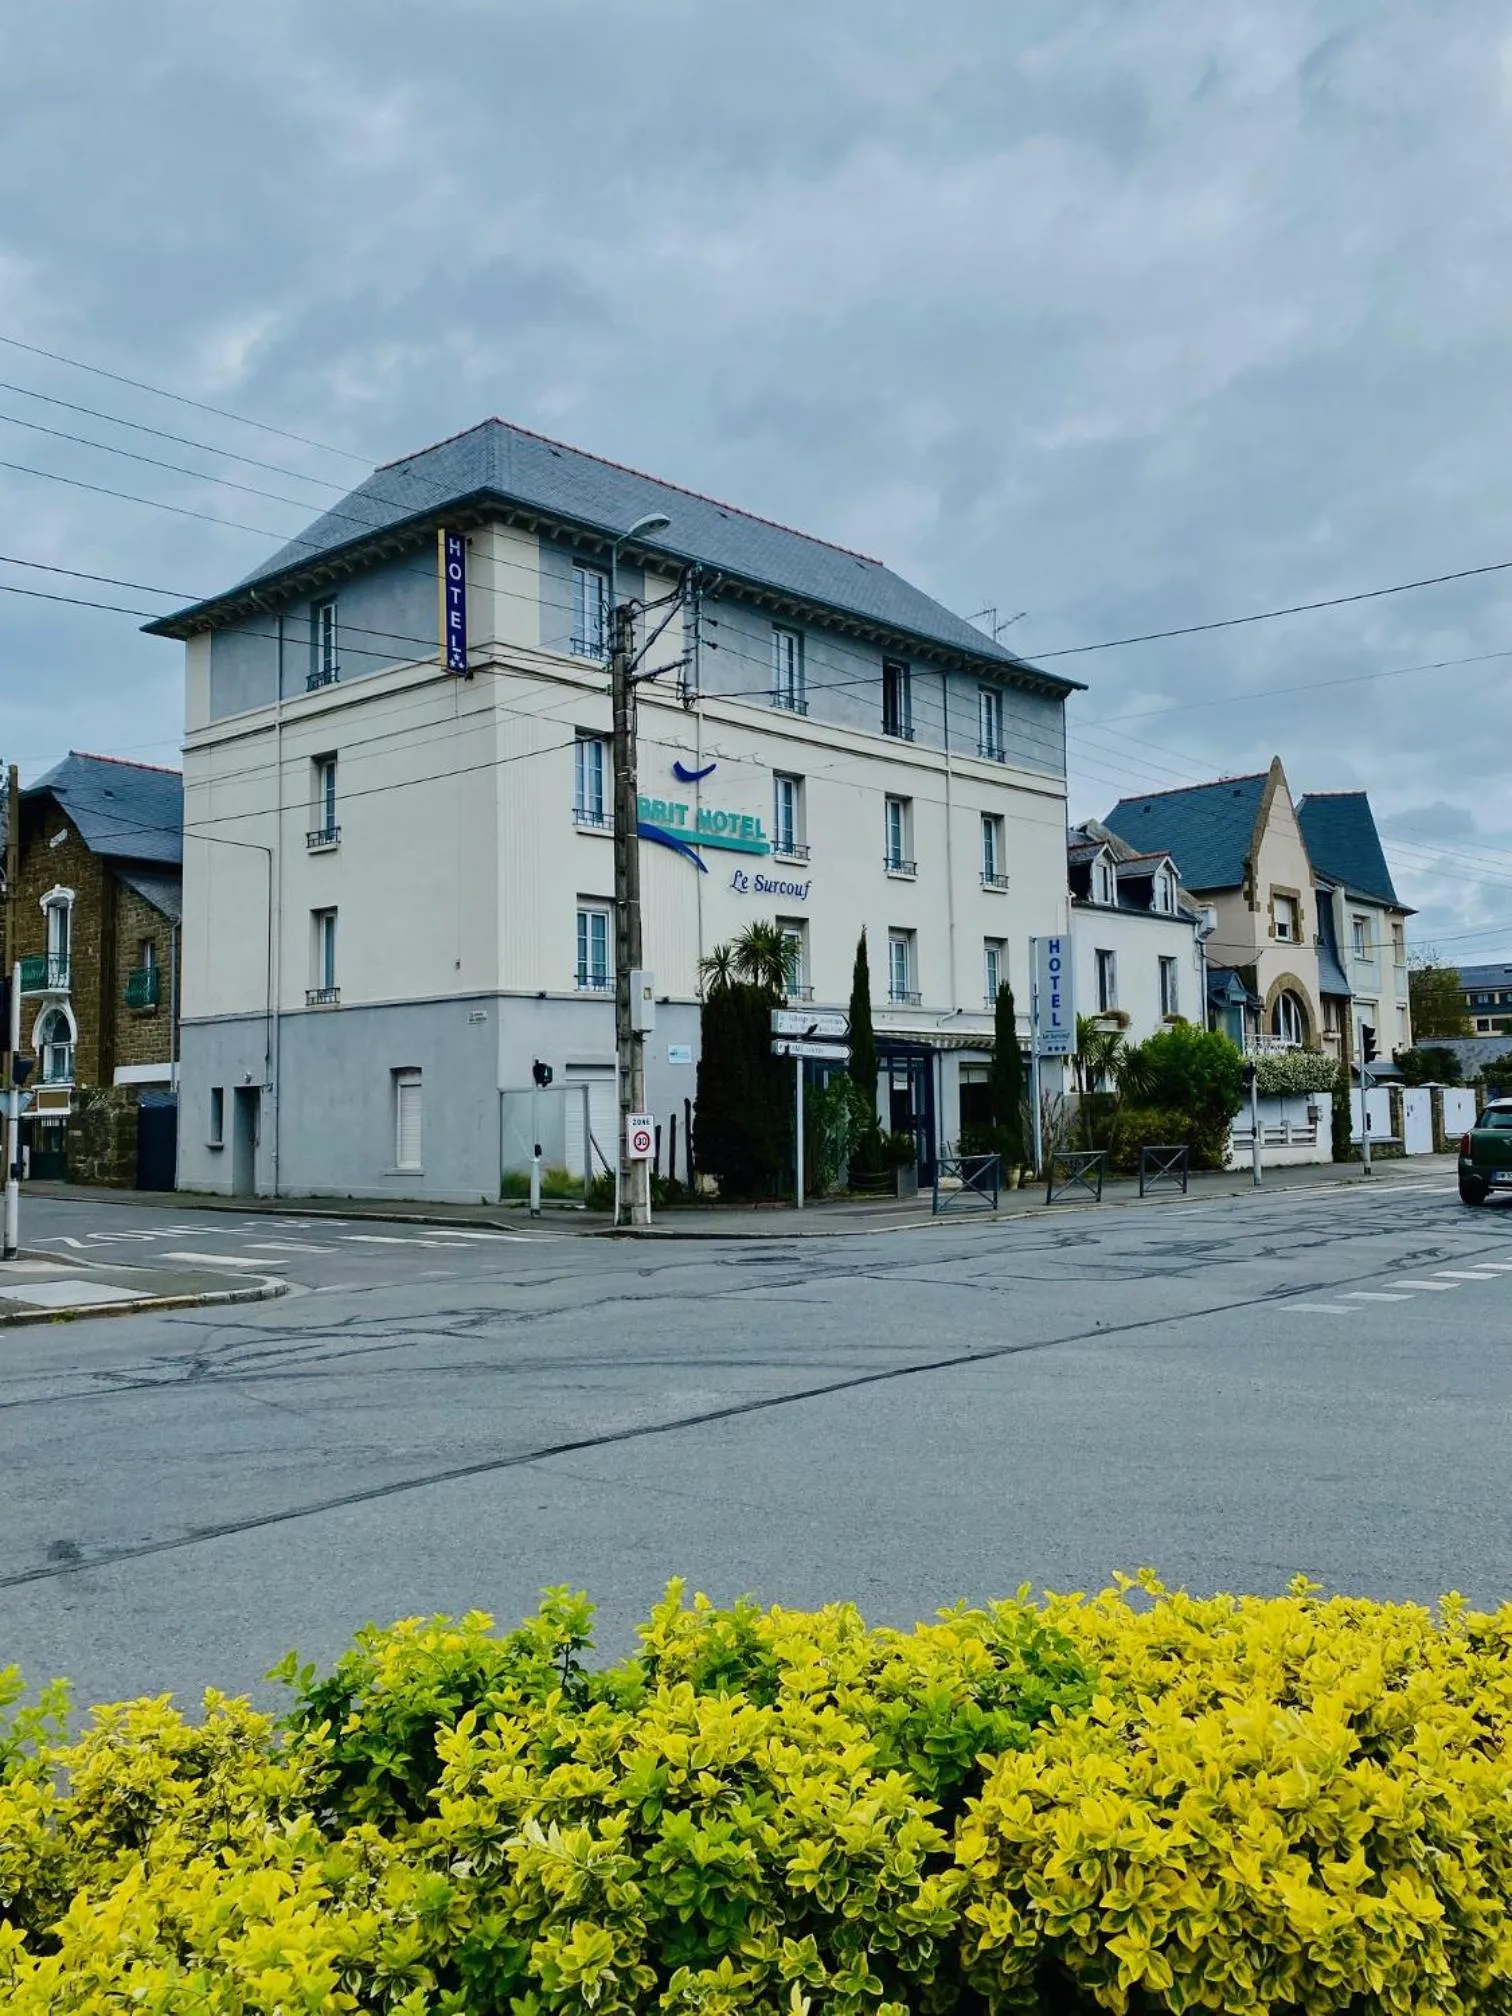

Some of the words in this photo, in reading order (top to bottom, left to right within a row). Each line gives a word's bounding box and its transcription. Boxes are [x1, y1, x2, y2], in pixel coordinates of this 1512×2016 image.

[448, 537, 462, 653] HOTEL
[637, 796, 688, 827] BRIT
[698, 808, 766, 839] HOTEL
[730, 869, 749, 894] Le
[754, 874, 812, 901] Surcouf
[1048, 939, 1062, 1026] HOTEL
[632, 1117, 651, 1126] ZONE
[637, 1136, 648, 1147] 30
